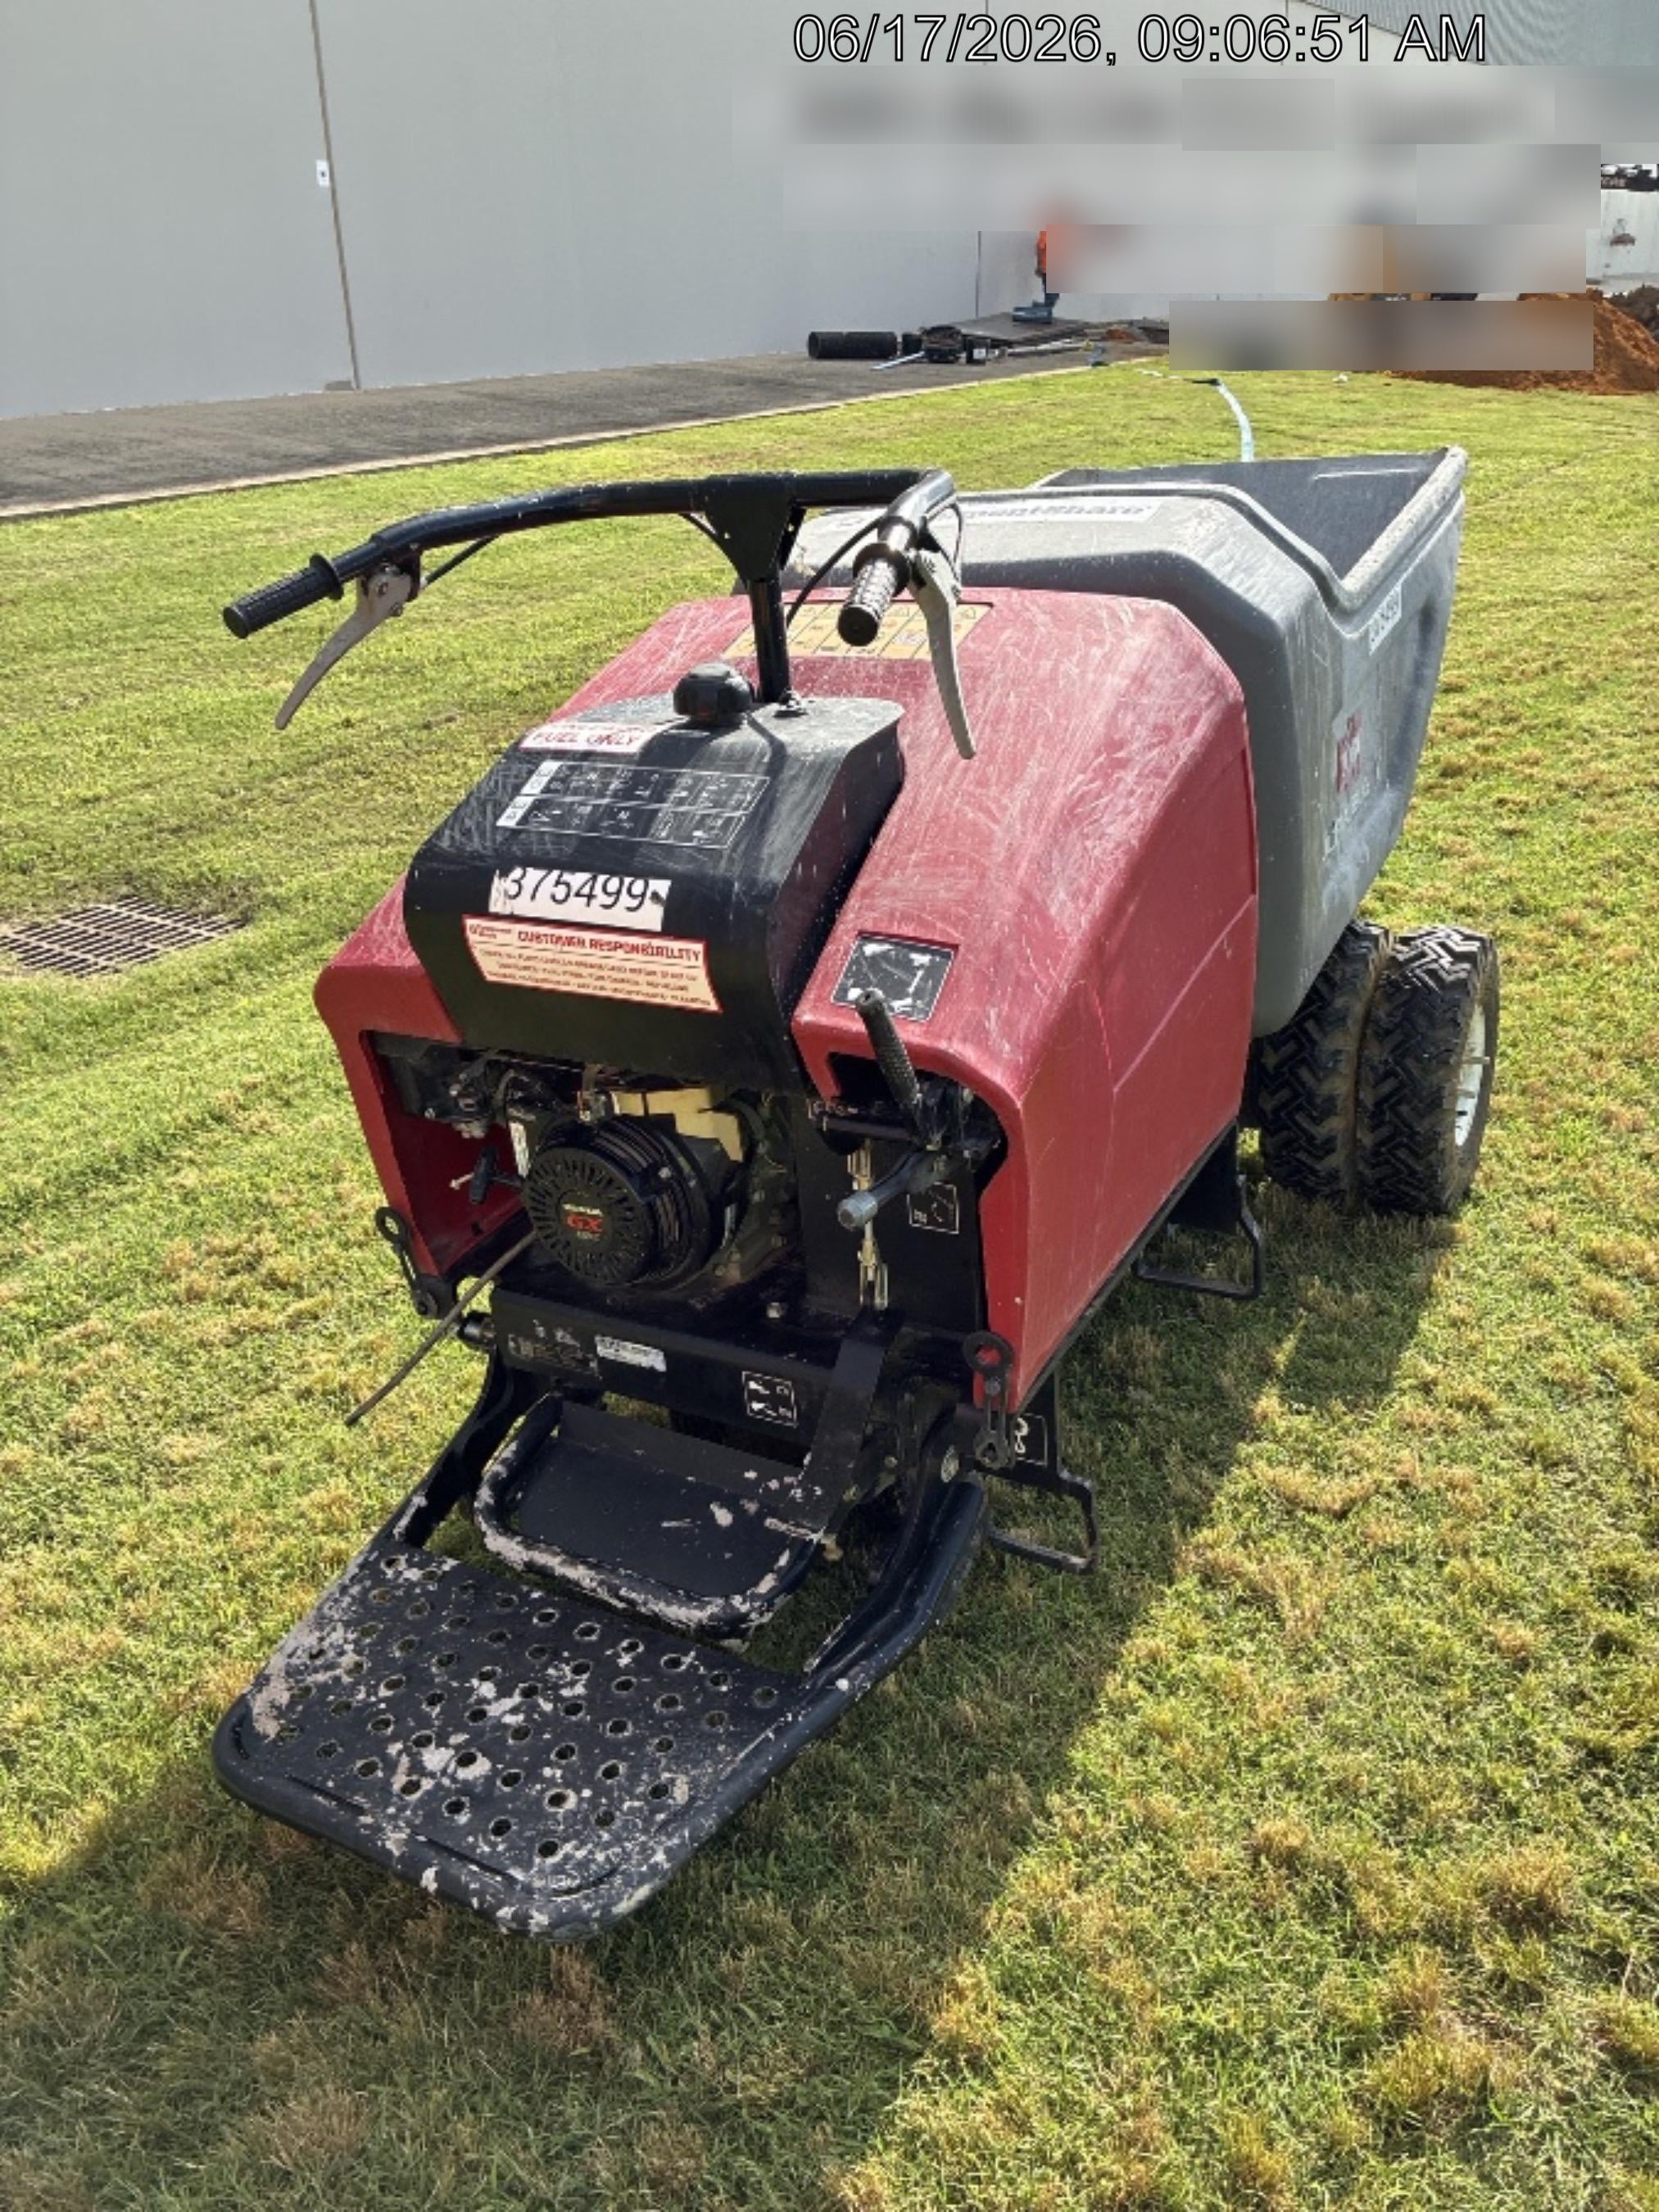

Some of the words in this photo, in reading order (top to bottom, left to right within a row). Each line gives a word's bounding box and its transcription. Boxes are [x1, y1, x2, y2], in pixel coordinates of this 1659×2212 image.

[506, 866, 650, 913] 375499
[518, 930, 587, 949] CUSTOMER
[588, 937, 701, 961] RESPONSIBILITY
